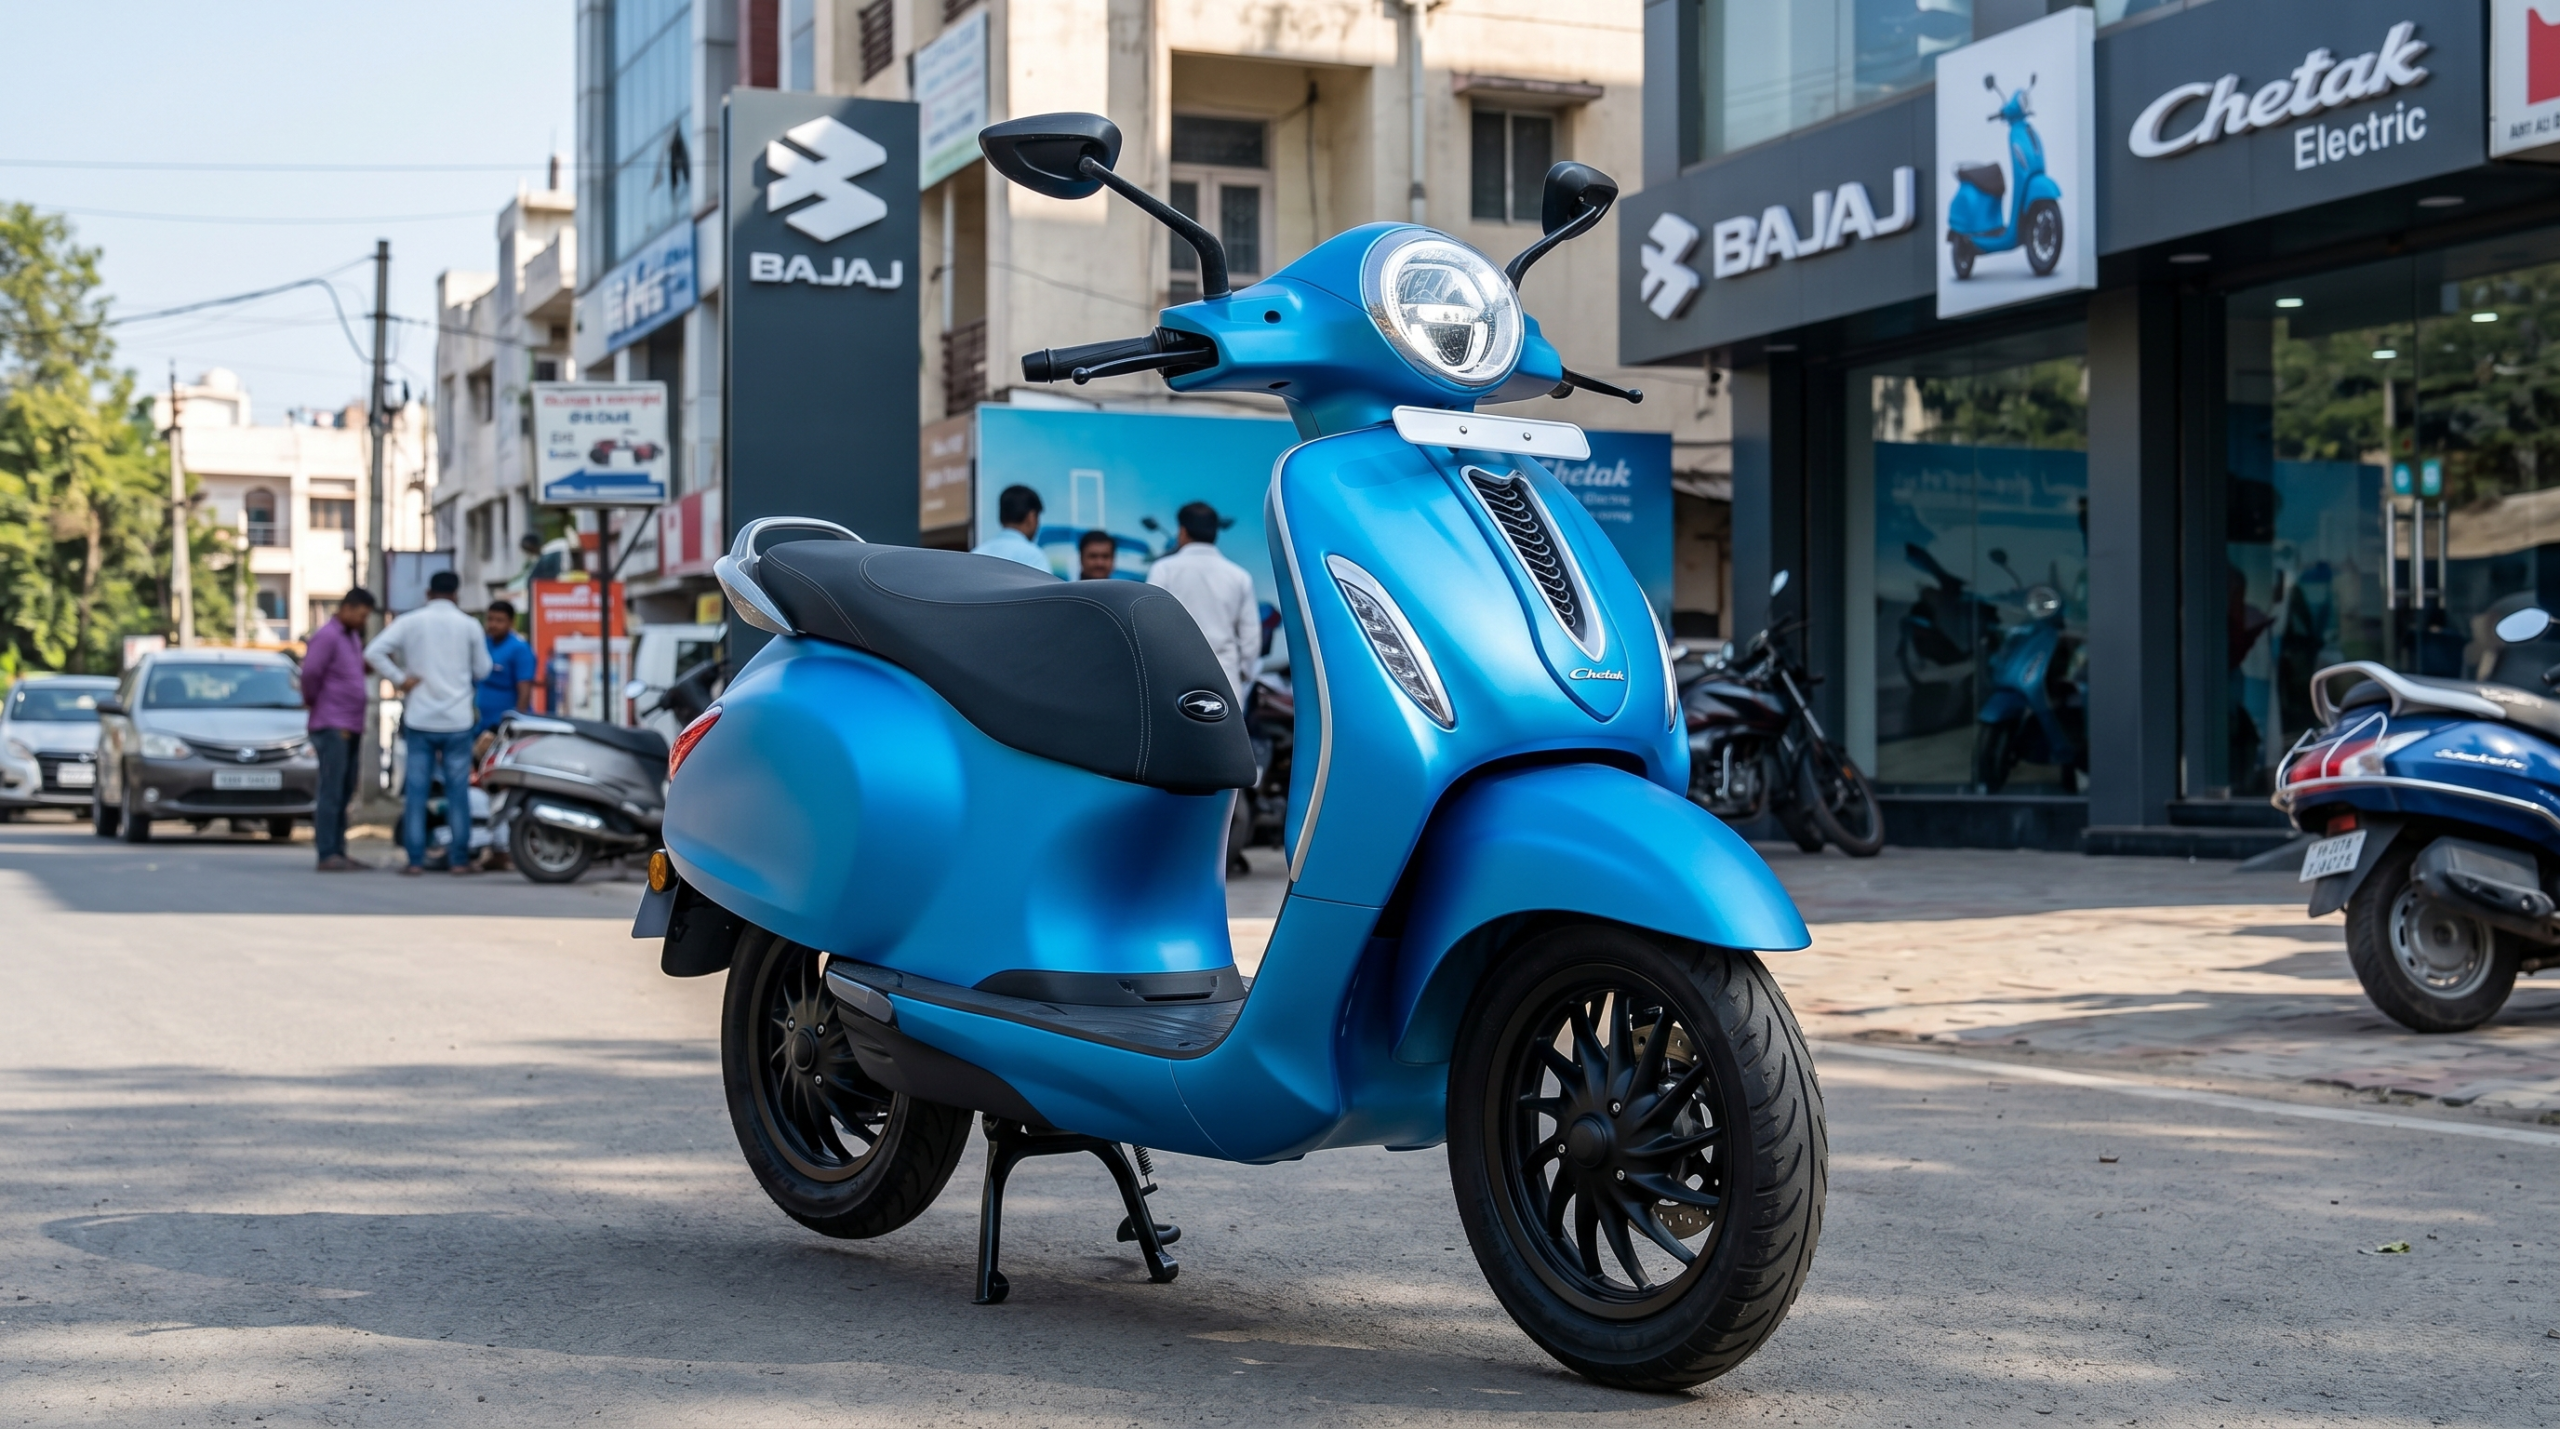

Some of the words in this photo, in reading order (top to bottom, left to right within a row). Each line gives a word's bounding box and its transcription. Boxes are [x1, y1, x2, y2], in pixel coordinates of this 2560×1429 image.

[2128, 20, 2429, 159] Chetak
[2294, 101, 2427, 171] Electric
[1713, 165, 1915, 280] BAJAJ
[750, 251, 903, 290] BAJAJ
[1568, 667, 1625, 682] Chetak
